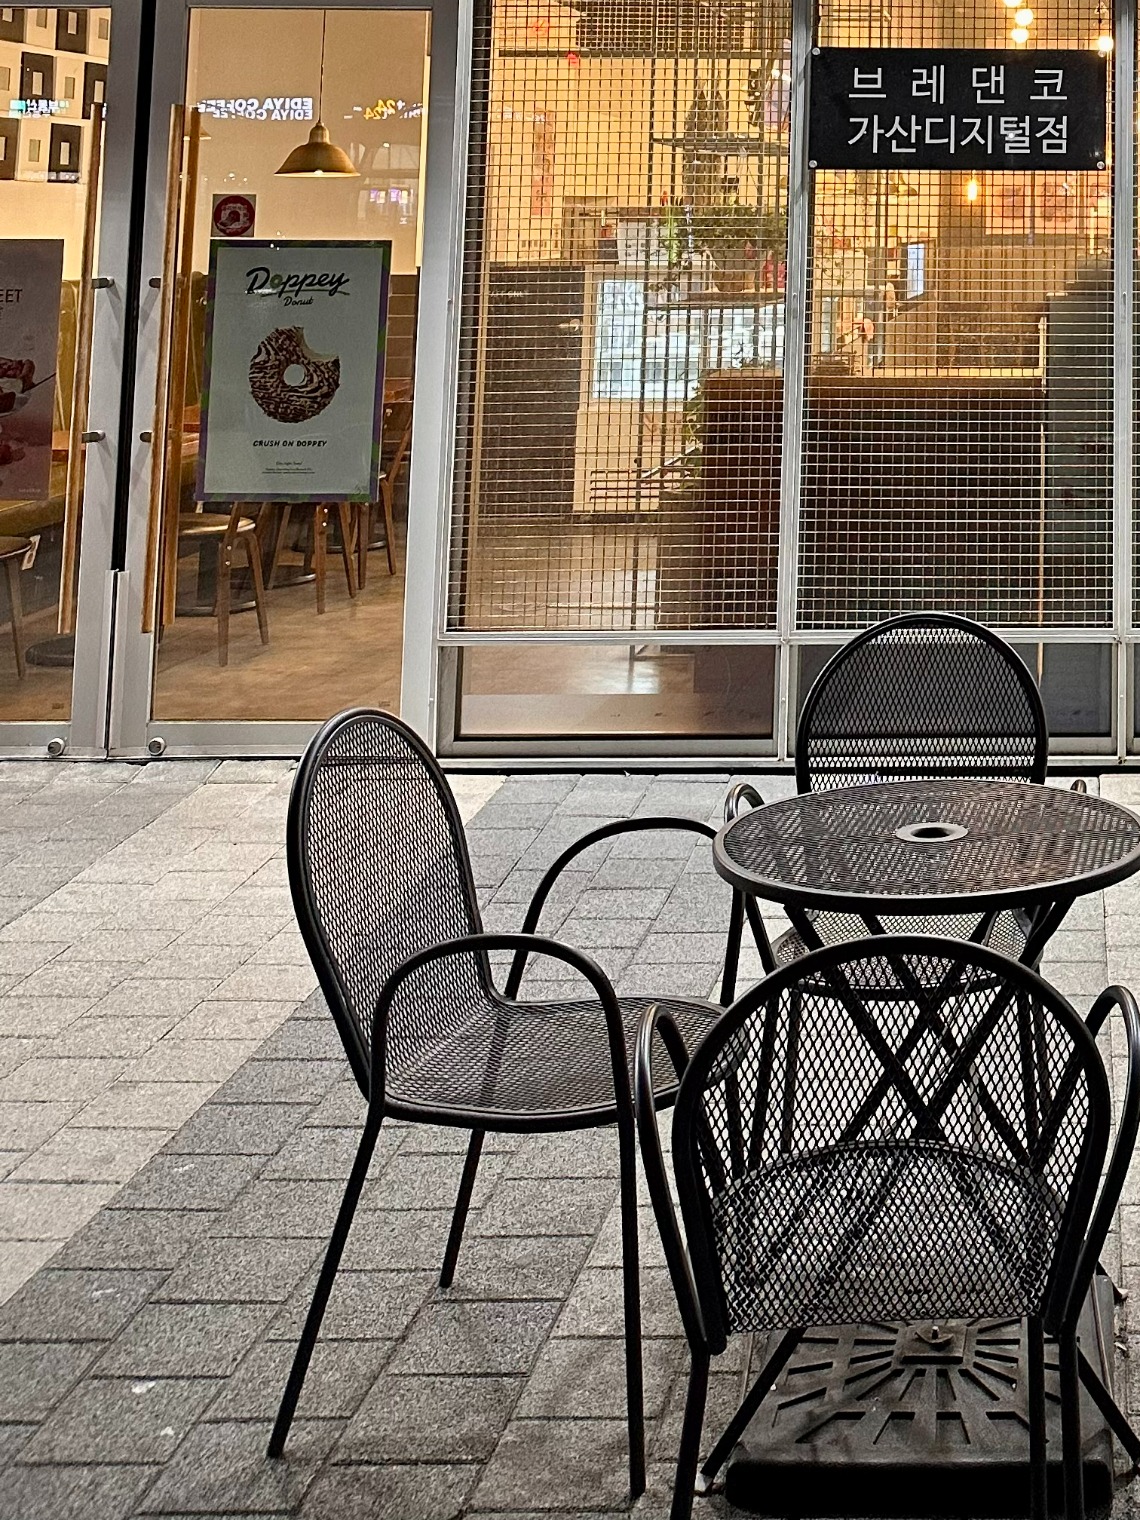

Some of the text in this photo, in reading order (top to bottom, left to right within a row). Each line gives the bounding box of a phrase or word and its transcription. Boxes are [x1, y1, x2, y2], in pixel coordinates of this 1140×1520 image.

[848, 114, 1068, 155] 가산디지털점
[246, 266, 350, 298] Doppey
[283, 296, 314, 307] Donut
